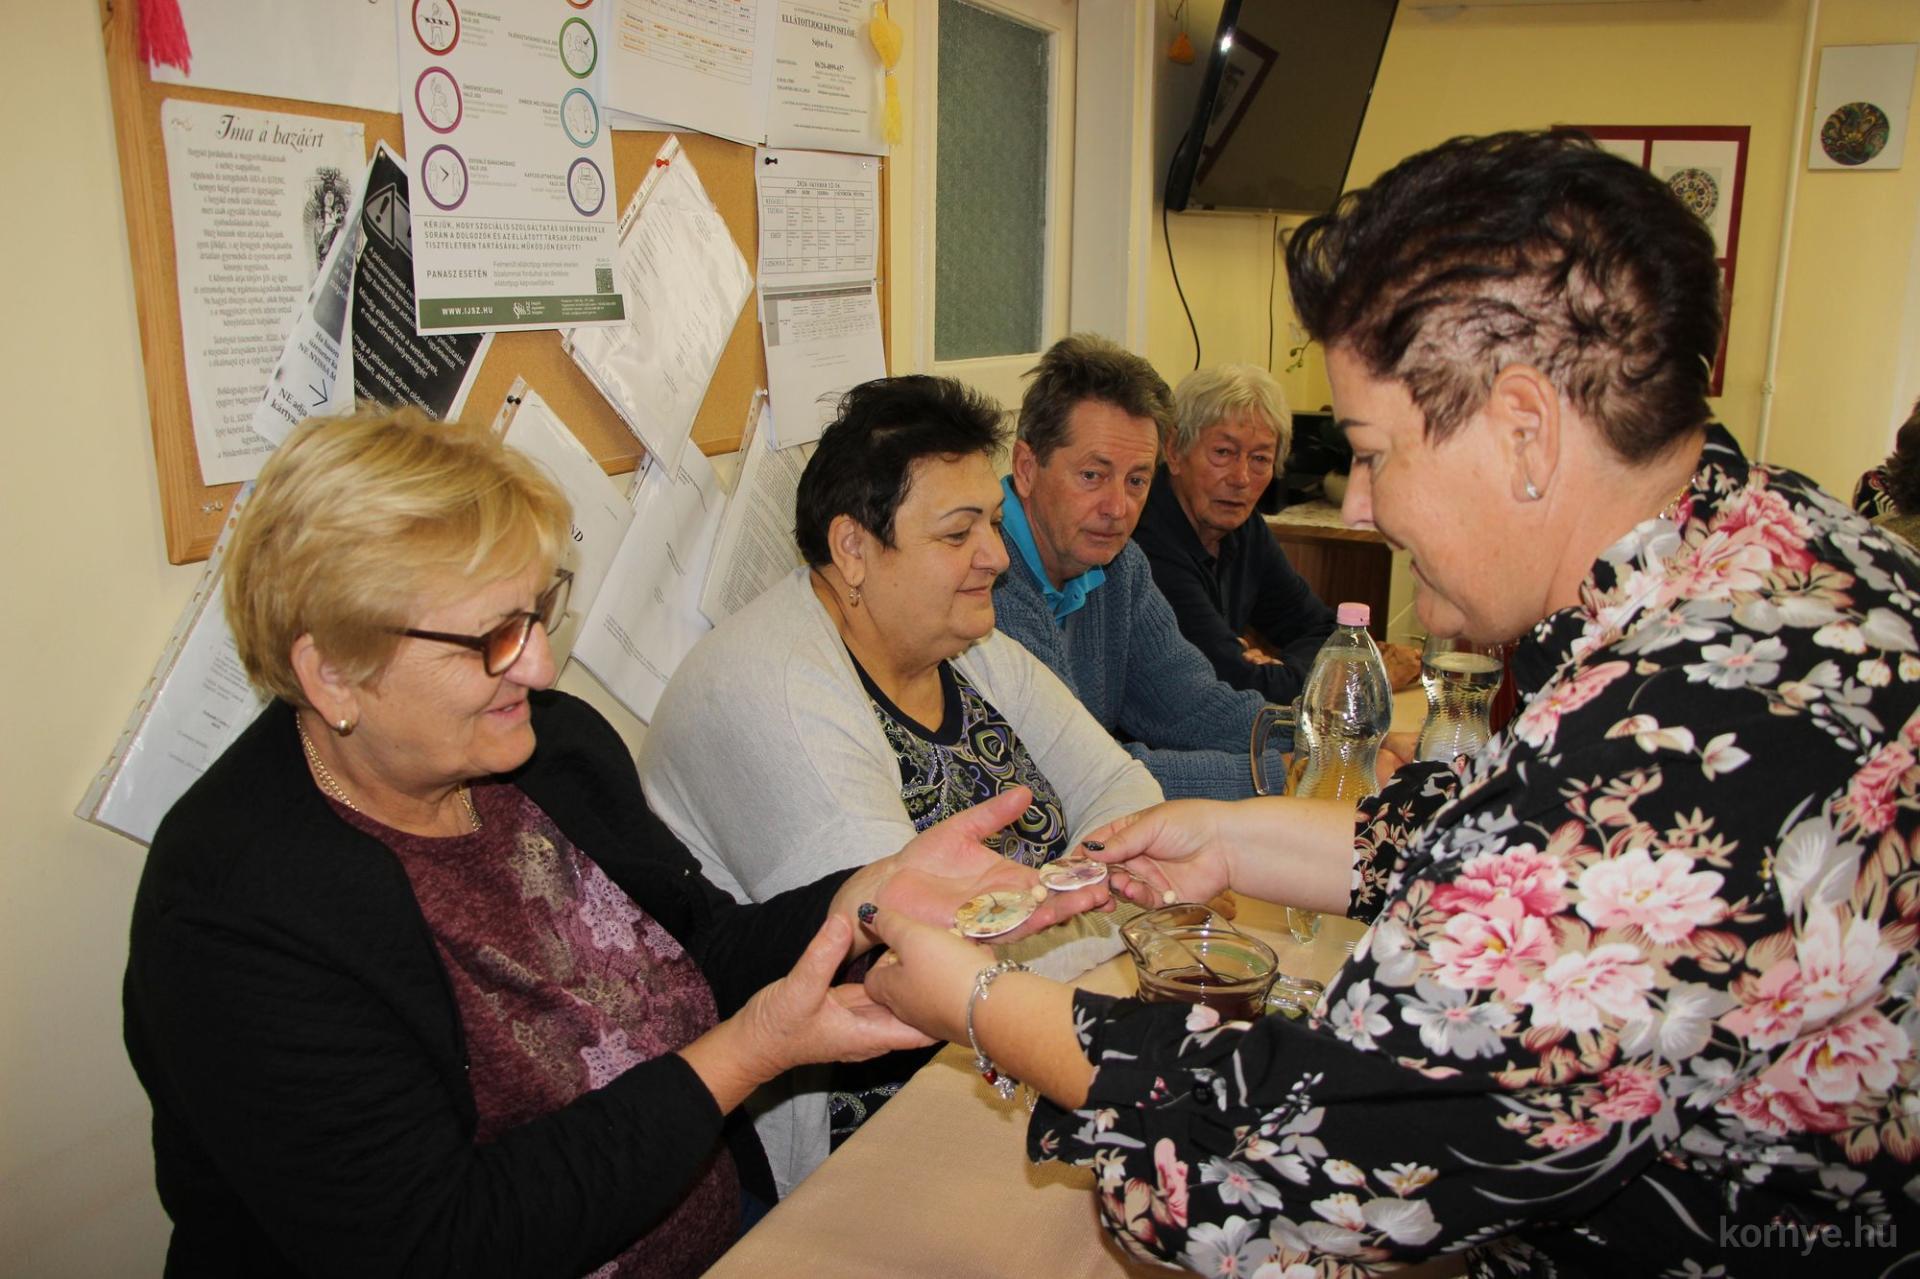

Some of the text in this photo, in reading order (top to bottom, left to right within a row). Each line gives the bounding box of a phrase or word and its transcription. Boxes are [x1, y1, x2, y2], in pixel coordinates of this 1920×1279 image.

[456, 221, 474, 230] HOGY
[425, 241, 476, 249] TISZTELETBEN
[426, 268, 488, 279] PANASZ ESETÉN
[441, 306, 494, 316] WWW.IJSZ.HU
[278, 388, 294, 403] NE
[291, 400, 308, 417] adja
[269, 399, 298, 426] kártya
